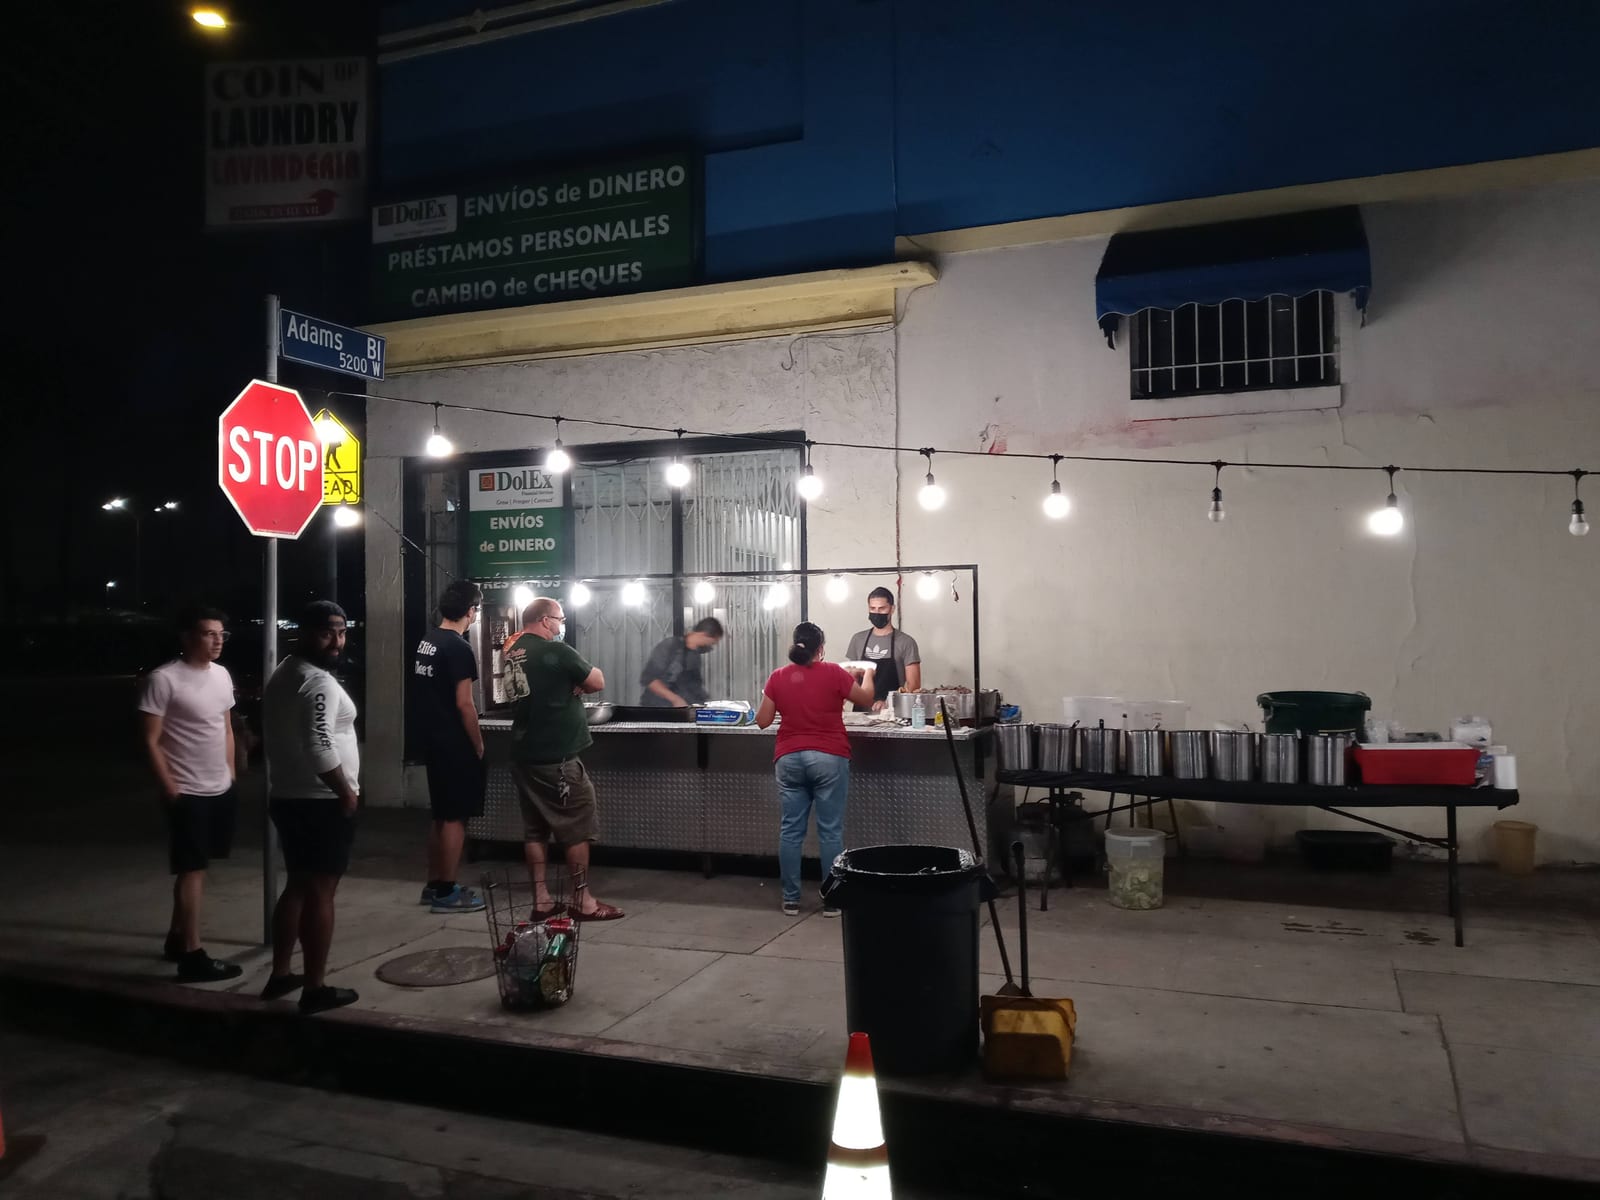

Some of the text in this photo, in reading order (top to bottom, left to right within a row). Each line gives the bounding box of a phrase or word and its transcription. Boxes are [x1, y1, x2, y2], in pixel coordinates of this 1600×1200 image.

[213, 64, 325, 100] COIN
[212, 101, 359, 148] LAUNDRY
[464, 165, 686, 217] ENVÍOS de DINERO
[396, 200, 447, 224] DolEx
[388, 215, 670, 272] PRÉSTAMOS PERSONALES
[411, 262, 643, 308] CAMBIO de CHEQUES
[287, 315, 381, 361] Adams Bl
[339, 353, 381, 377] 5200 W
[228, 426, 317, 491] STOP
[496, 470, 553, 491] DolEx
[490, 512, 544, 530] ENVÍOS
[479, 538, 556, 553] de DINERO
